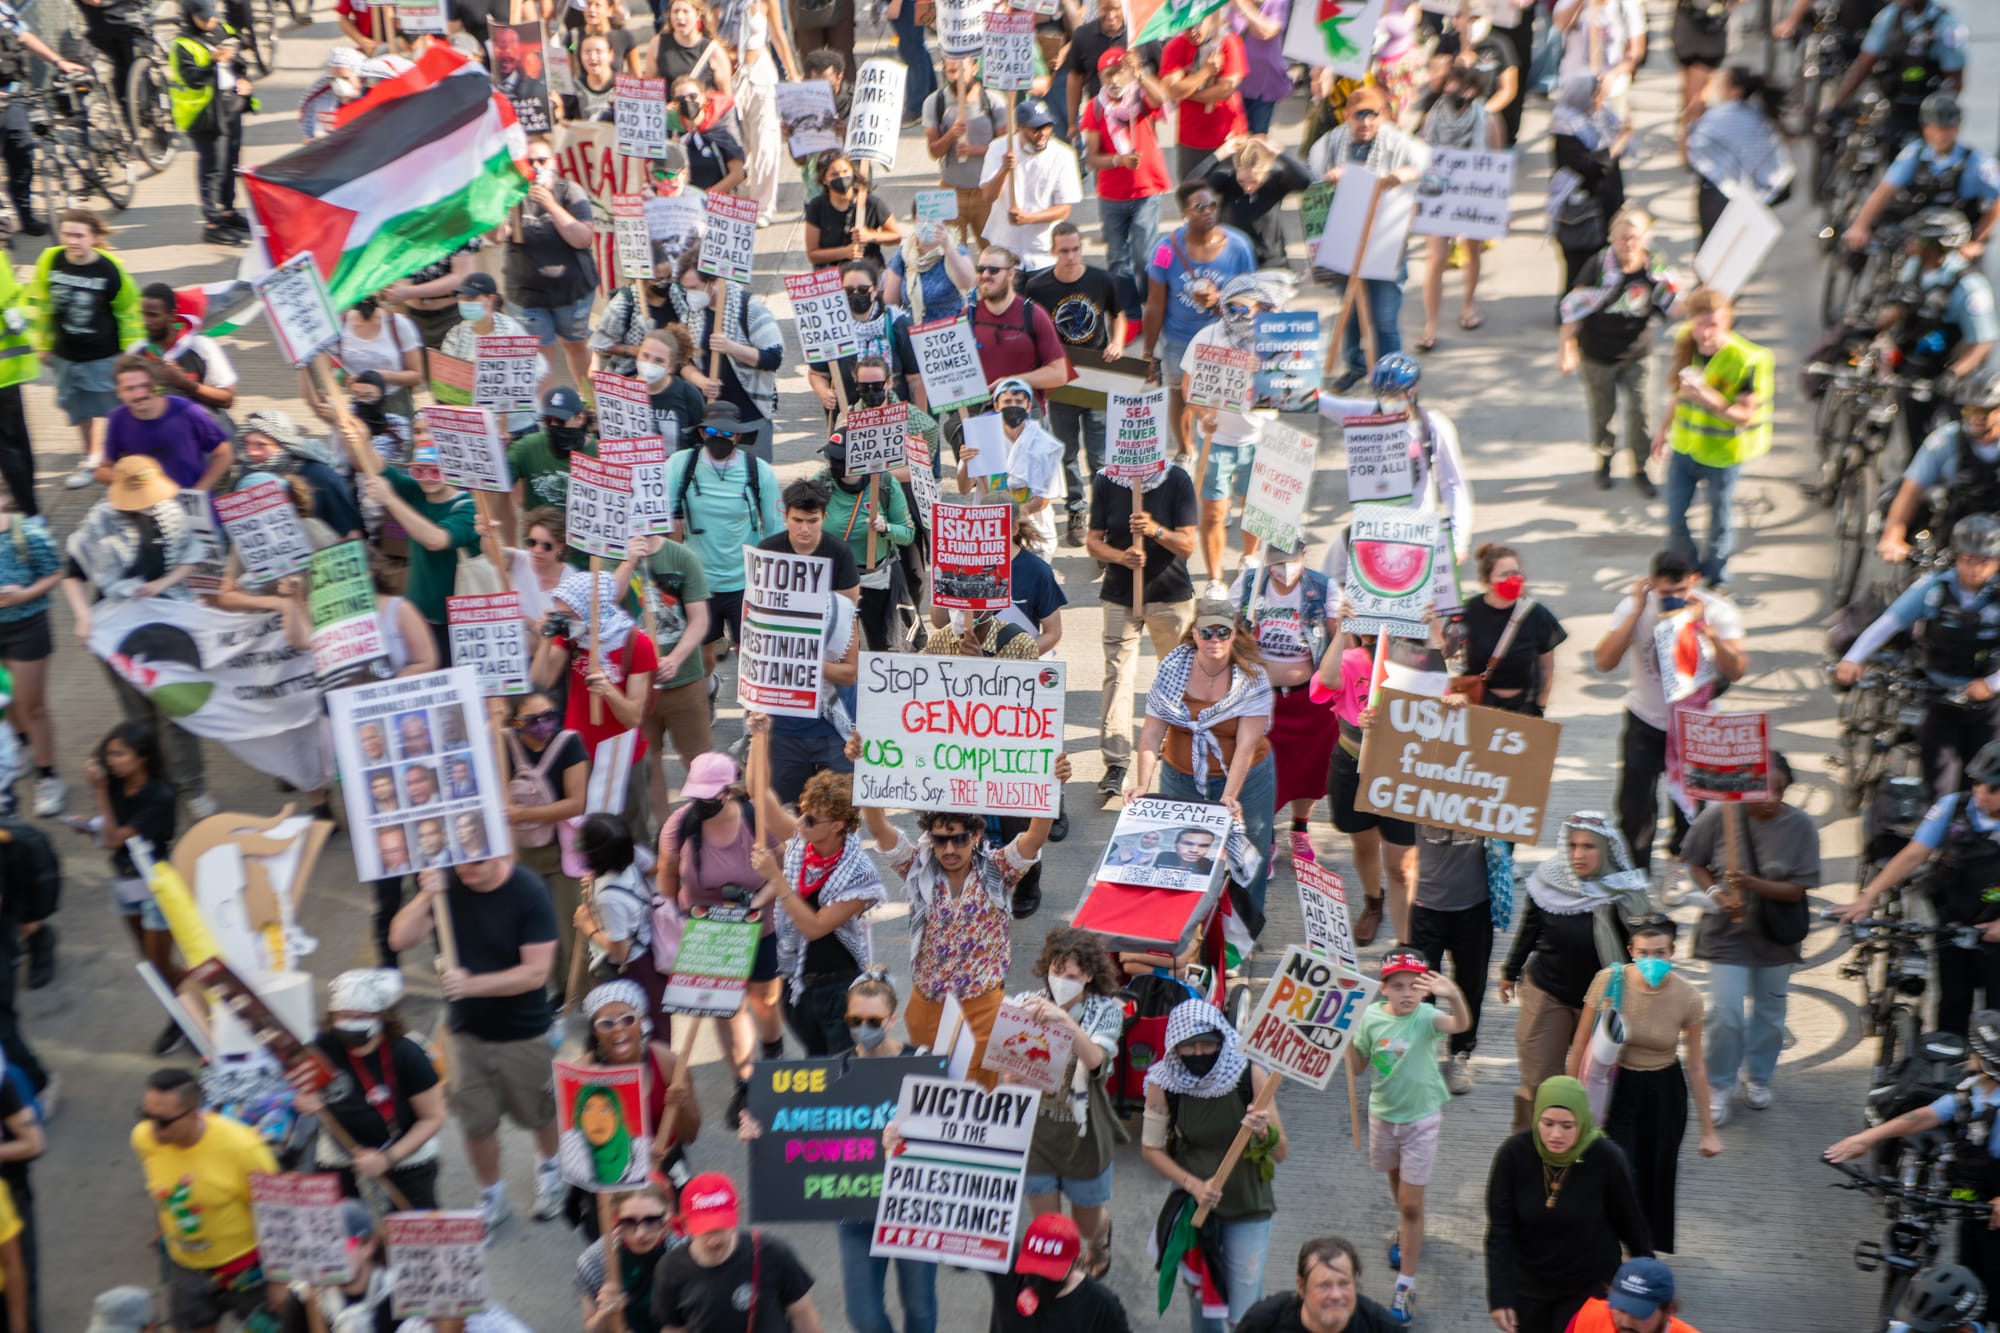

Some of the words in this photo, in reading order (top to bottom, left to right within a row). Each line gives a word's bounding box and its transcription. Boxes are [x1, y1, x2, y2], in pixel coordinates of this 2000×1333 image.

[708, 217, 728, 230] END
[705, 232, 726, 245] AID
[734, 237, 749, 250] TO
[786, 275, 813, 288] STAND
[816, 270, 839, 283] WITH
[795, 302, 817, 315] END
[800, 316, 821, 330] AID
[830, 310, 846, 323] TO
[1260, 323, 1286, 333] END
[1288, 322, 1313, 332] THE
[803, 327, 850, 344] ISRAEL!
[925, 331, 956, 346] STOP
[924, 343, 966, 360] POLICE
[1256, 341, 1318, 352] GENOCIDE
[478, 361, 505, 371] END
[926, 356, 971, 374] CRIMES!
[1262, 360, 1273, 370] IN
[1280, 360, 1314, 370] GAZA
[478, 373, 504, 384] AID
[513, 372, 532, 383] TO
[595, 373, 622, 385] STAND
[624, 379, 646, 390] WITH
[600, 397, 622, 411] END
[1113, 395, 1142, 406] FROM
[1145, 392, 1163, 404] THE
[849, 409, 880, 420] STAND
[882, 403, 906, 414] WITH
[1126, 407, 1150, 418] SEA
[602, 412, 623, 425] AID
[630, 417, 647, 431] TO
[848, 413, 906, 429] PALESTINE!
[1121, 419, 1134, 428] TO
[1137, 417, 1155, 427] THE
[851, 430, 877, 441] END
[1119, 427, 1156, 439] RIVER
[1347, 430, 1403, 444] IMMIGRANT
[851, 440, 876, 453] AID
[885, 435, 903, 446] TO
[1116, 437, 1158, 448] PALESTINE
[1140, 446, 1155, 454] LIVE
[1350, 445, 1382, 454] RIGHTS
[1386, 442, 1404, 451] AND
[851, 447, 903, 463] ISRAEL!
[1112, 452, 1160, 464] FOREVER!
[571, 455, 601, 470] STAND
[604, 463, 630, 476] WITH
[1351, 464, 1375, 477] FOR
[1380, 461, 1407, 475] ALL!
[572, 484, 596, 501] END
[570, 500, 595, 518] AID
[604, 510, 624, 524] TO
[937, 506, 962, 518] STOP
[964, 507, 1005, 520] ARMING
[570, 517, 625, 540] ISRAEL!
[938, 518, 1006, 540] ISRAEL
[938, 540, 945, 551] &
[947, 541, 977, 553] FUND
[980, 541, 1005, 553] OUR
[938, 552, 1005, 566] COMMUNITIES
[754, 589, 763, 604] TO
[768, 591, 789, 608] THE
[1369, 598, 1381, 611] BE
[1390, 593, 1421, 611] FREE
[1263, 633, 1292, 642] FREE
[868, 657, 928, 699] Stop
[902, 700, 1058, 739] GENOCIDE
[1684, 714, 1713, 725] STOP
[1488, 728, 1527, 755] is
[1685, 724, 1759, 744] ISRAEL
[1686, 751, 1761, 765] COMMUNITIES
[1697, 743, 1729, 756] FUND
[1732, 744, 1760, 755] OUR
[915, 755, 926, 768] is
[934, 743, 1054, 781] COMPLICIT
[1400, 743, 1510, 802] funding
[861, 774, 917, 802] Students
[950, 778, 978, 803] FREE
[985, 782, 1052, 807] PALESTINE
[1132, 800, 1168, 810] YOU
[1172, 804, 1208, 814] CAN
[1368, 777, 1538, 836] GENOCIDE
[1127, 808, 1172, 819] SAVE
[1173, 812, 1185, 821] A
[1191, 814, 1226, 825] LIFE
[1293, 860, 1320, 877] STAND
[1323, 872, 1342, 888] WITH
[1302, 889, 1324, 907] END
[1306, 906, 1327, 924] AID
[1330, 917, 1347, 936] TO
[1308, 921, 1352, 953] ISRAEL!
[1286, 953, 1330, 987] NO
[1310, 1027, 1340, 1049] IN
[772, 1068, 827, 1093] USE
[910, 1084, 1032, 1128] VICTORY
[941, 1121, 957, 1138] TO
[962, 1123, 988, 1144] THE
[786, 1137, 876, 1163] POWER
[888, 1166, 1017, 1203] PALESTINIAN
[883, 1197, 1013, 1236] RESISTANCE
